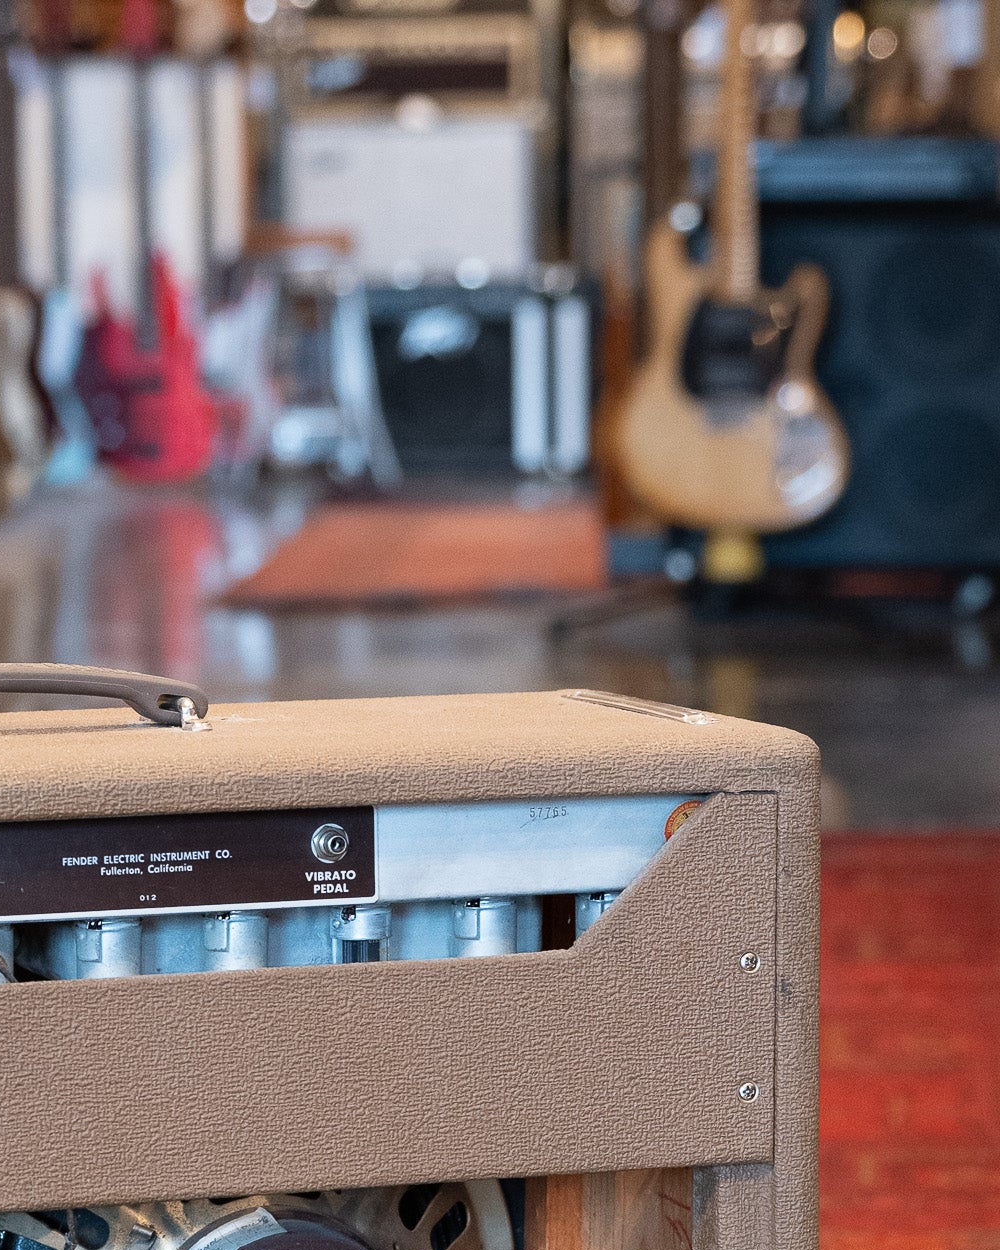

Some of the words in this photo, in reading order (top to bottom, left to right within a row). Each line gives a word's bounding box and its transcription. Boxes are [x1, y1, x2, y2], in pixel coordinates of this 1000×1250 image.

[529, 805, 568, 819] 57765
[62, 856, 98, 867] FENDER
[103, 853, 145, 865] ELECTRIC
[150, 850, 210, 862] INSTRUMENT
[215, 849, 233, 860] CO.
[100, 865, 143, 876] Fullerton,
[147, 863, 193, 874] California
[304, 869, 356, 882] VIBRATO
[313, 882, 350, 894] PEDAL
[139, 894, 157, 902] 012
